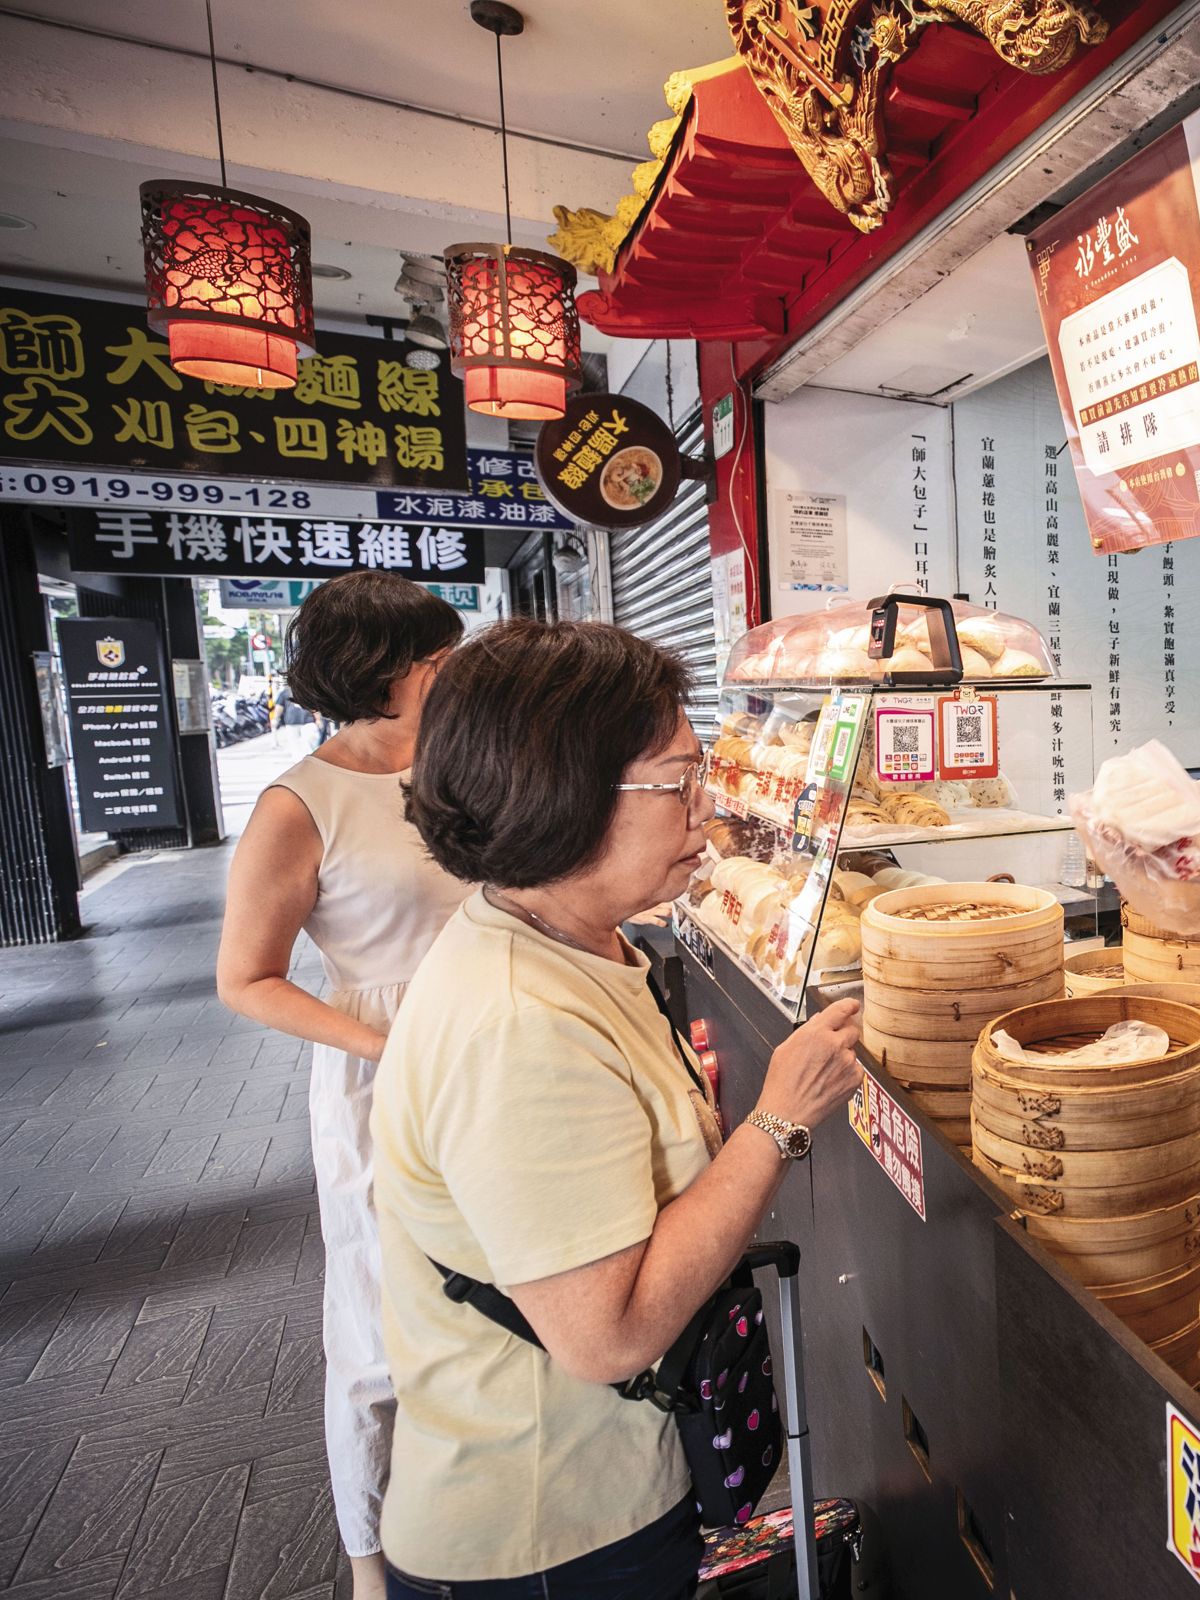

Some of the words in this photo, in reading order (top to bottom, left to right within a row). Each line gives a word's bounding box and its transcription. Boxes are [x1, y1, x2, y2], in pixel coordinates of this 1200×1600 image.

[1074, 206, 1139, 278] 永豐盛
[105, 327, 441, 417] 大麵線
[112, 398, 444, 471] 刈包、四神湯
[557, 408, 630, 490] 大腸麵線
[1097, 411, 1158, 455] 請排隊
[0, 472, 311, 509] :0919-999-128
[95, 510, 469, 572] 手機快速維修
[953, 705, 984, 715] TWQR
